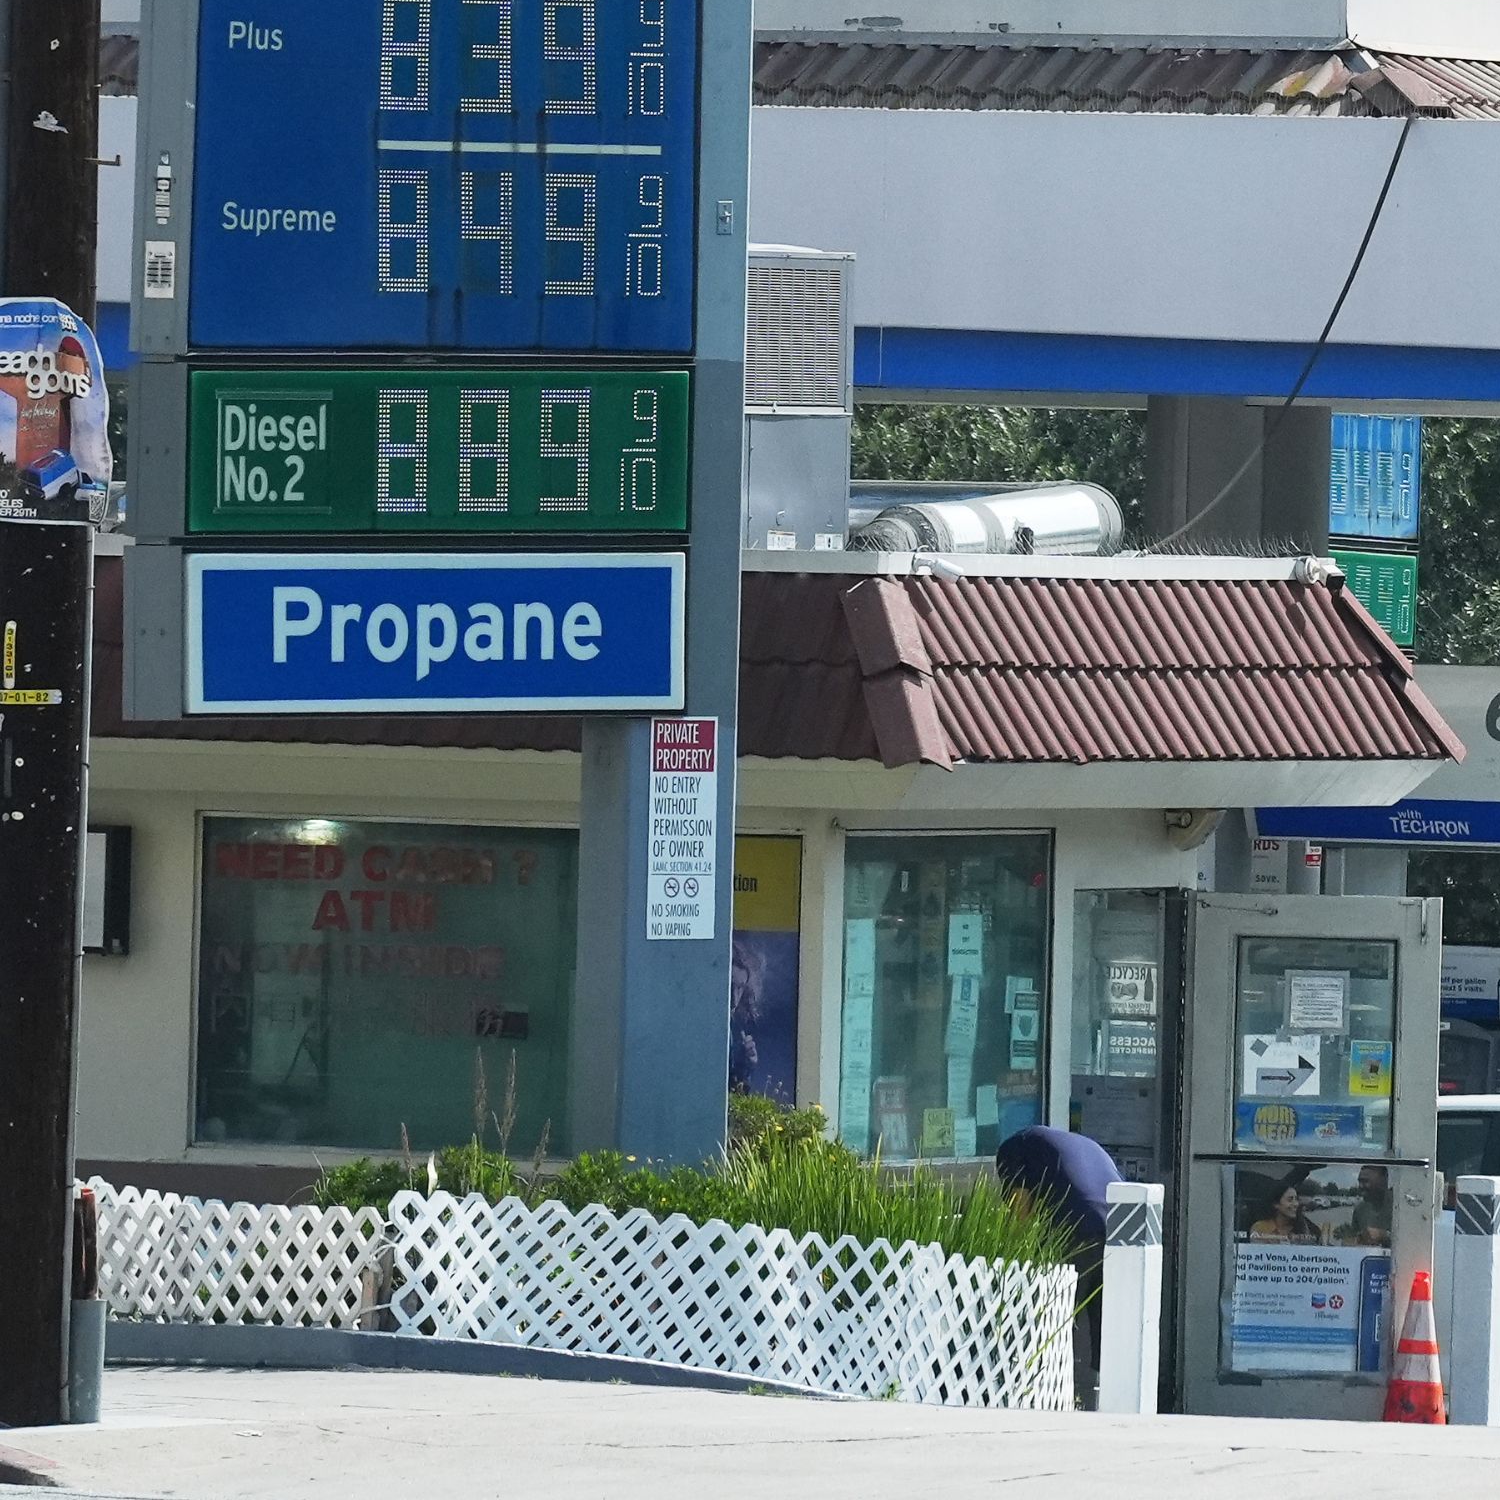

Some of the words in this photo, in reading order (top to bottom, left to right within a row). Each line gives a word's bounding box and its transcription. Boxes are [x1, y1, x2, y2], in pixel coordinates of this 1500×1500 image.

[228, 21, 283, 51] Plus
[222, 203, 336, 236] Supreme
[378, 170, 596, 296] 849
[26, 370, 91, 399] goons
[224, 405, 327, 451] Diesel
[377, 389, 590, 512] 889
[273, 586, 602, 682] Propane
[656, 723, 699, 744] PRIVATE
[656, 748, 712, 769] PROPERTY
[655, 776, 669, 793] NO
[672, 776, 701, 794] ENTRY
[655, 798, 698, 815] WITHOUT
[1398, 809, 1422, 820] with
[654, 819, 712, 836] PERMISSION
[1389, 817, 1470, 836] TECHRON
[653, 840, 666, 857] OF
[668, 840, 704, 858] OWNER
[215, 843, 345, 880] NEED
[653, 862, 667, 871] LAMC
[669, 862, 693, 872] SECTION
[312, 890, 438, 932] ATM
[651, 904, 663, 916] NO
[665, 904, 700, 917] SMOKING
[651, 923, 663, 935] NO
[664, 923, 691, 936] VAPING
[1291, 1254, 1340, 1265] Albertsons,
[1249, 1263, 1286, 1272] Pavilions
[1289, 1265, 1298, 1273] to
[1322, 1266, 1350, 1275] Points
[1270, 1275, 1281, 1284] up
[1284, 1275, 1294, 1283] to
